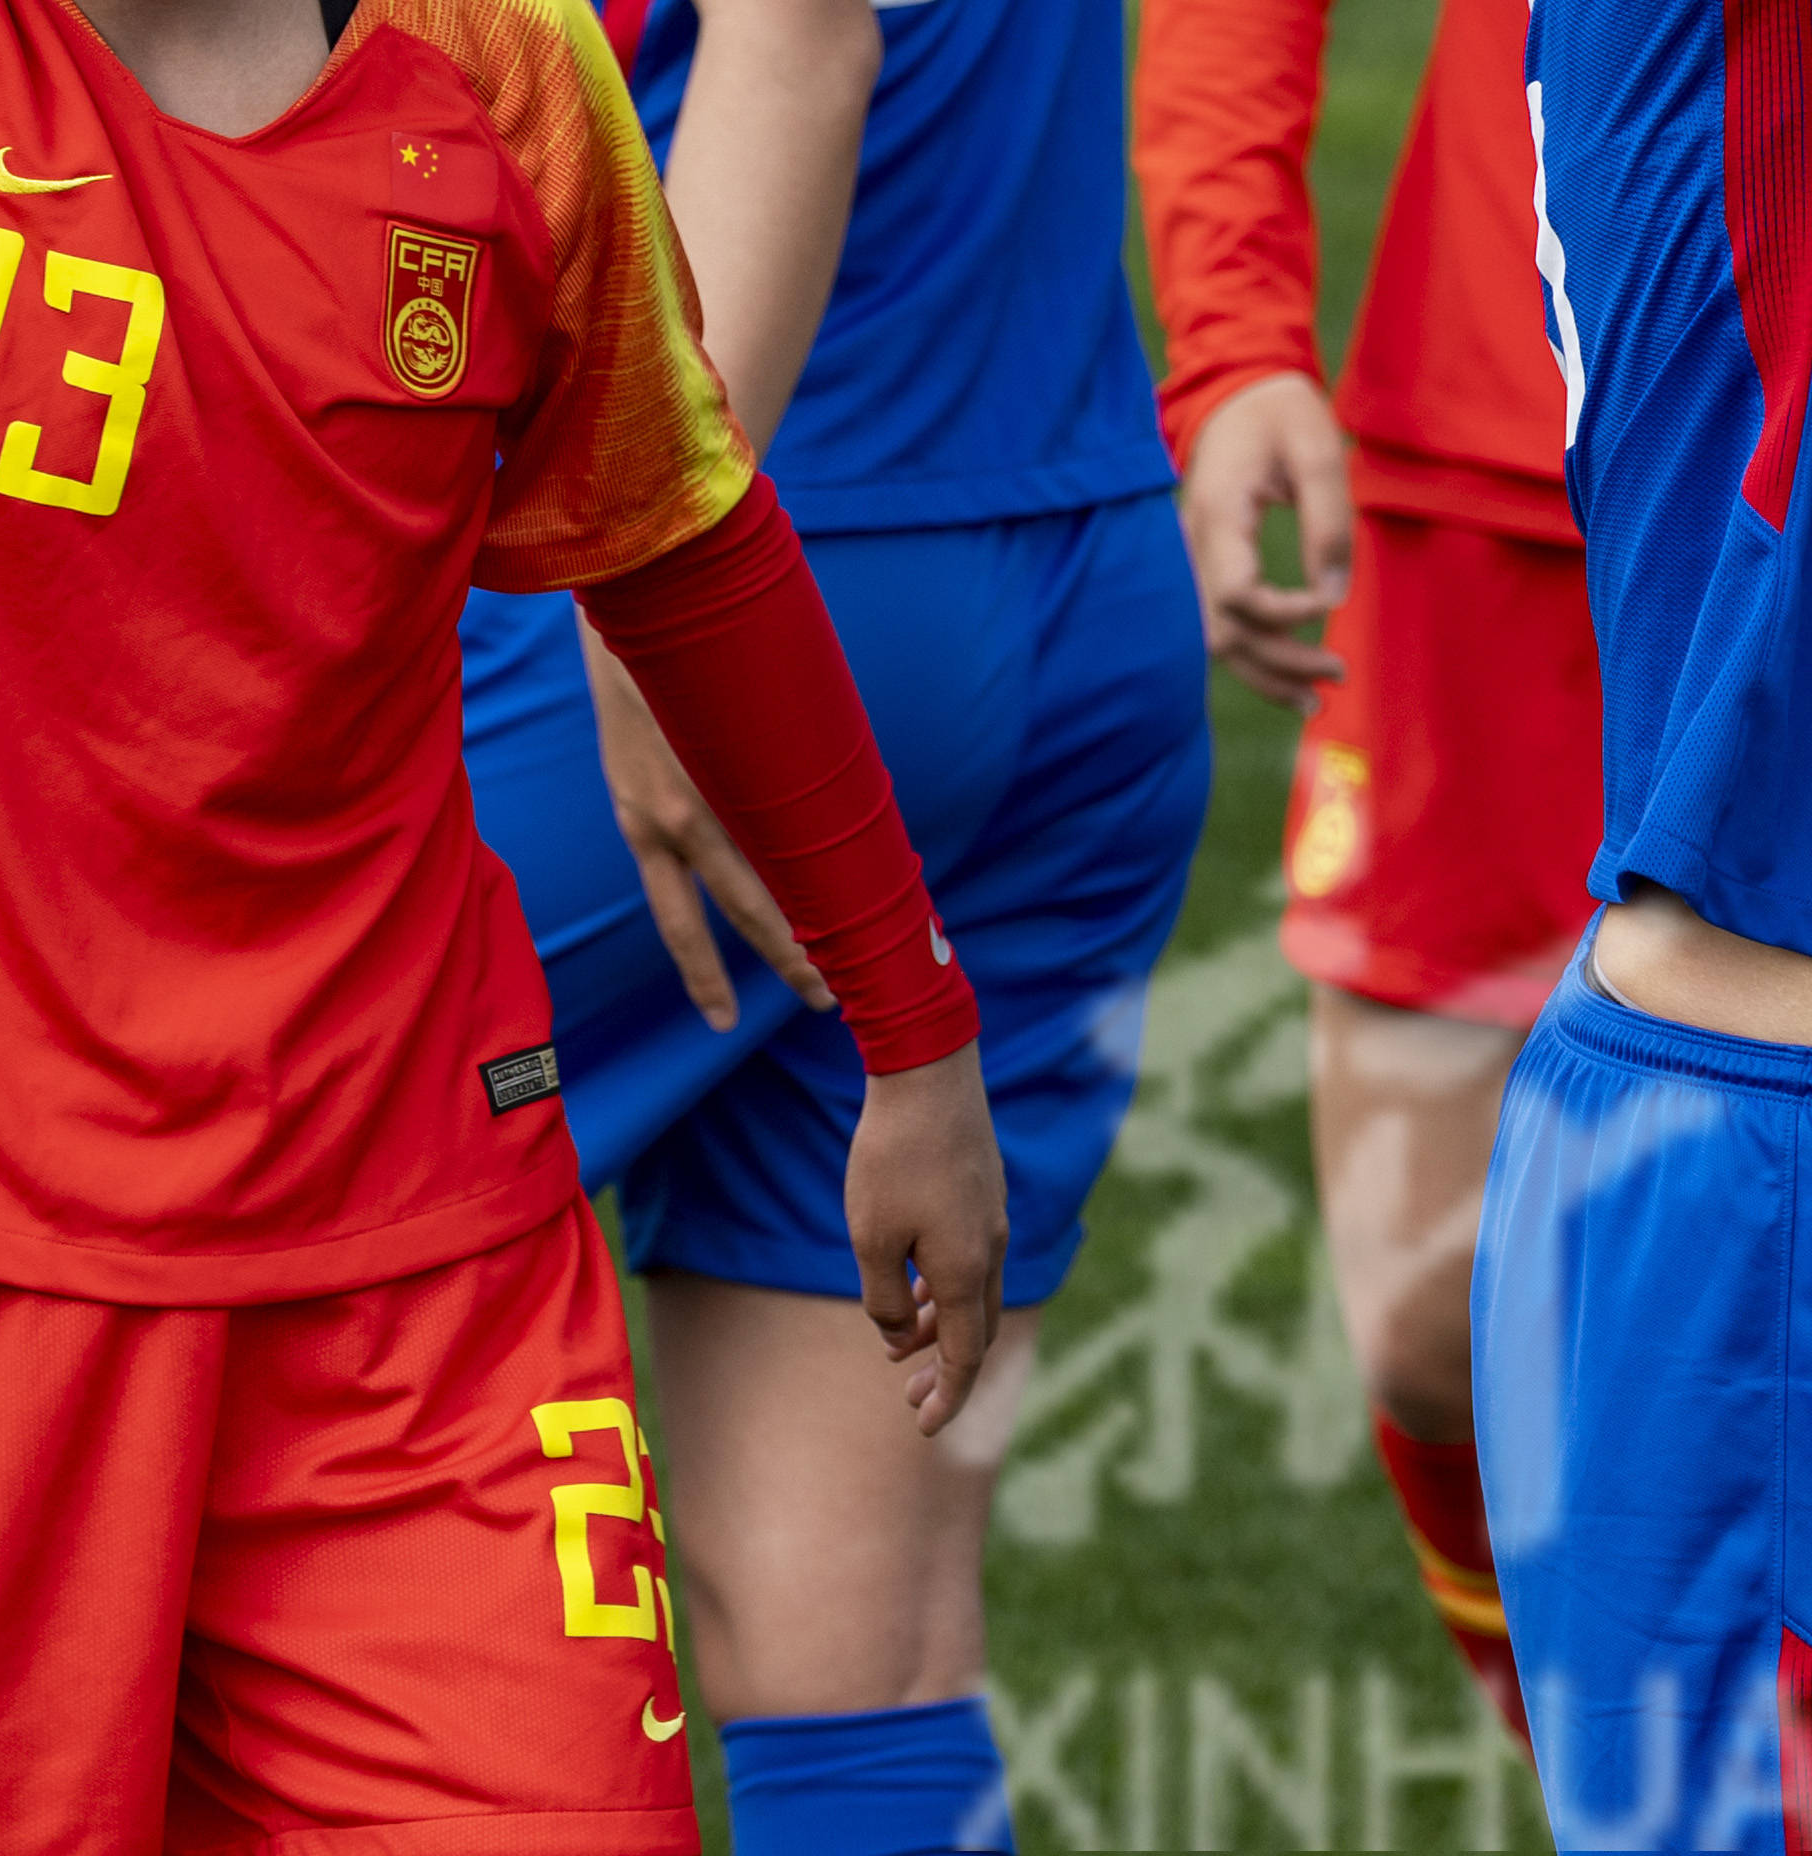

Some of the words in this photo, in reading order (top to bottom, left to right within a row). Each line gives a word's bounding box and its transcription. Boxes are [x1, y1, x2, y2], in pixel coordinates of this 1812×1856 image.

[398, 241, 468, 282] CFA
[417, 275, 444, 298] 中国
[530, 1397, 676, 1665] 2
